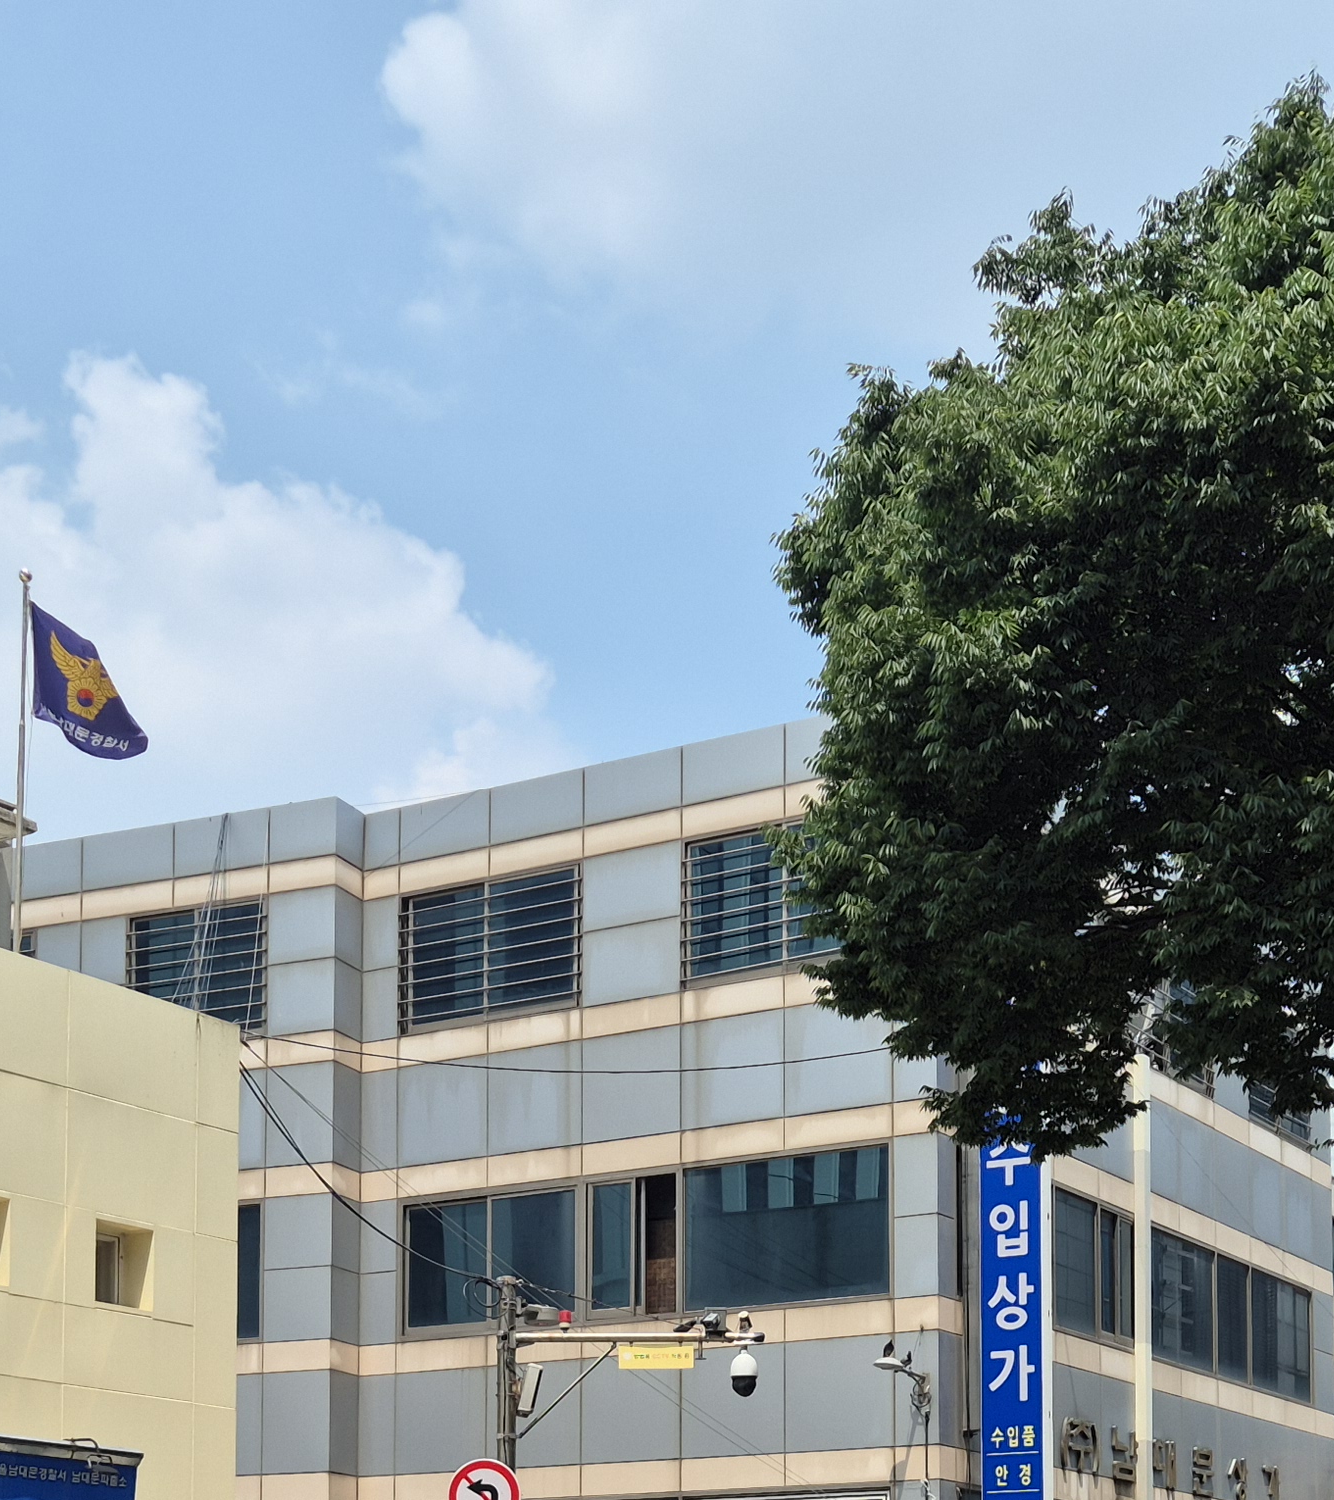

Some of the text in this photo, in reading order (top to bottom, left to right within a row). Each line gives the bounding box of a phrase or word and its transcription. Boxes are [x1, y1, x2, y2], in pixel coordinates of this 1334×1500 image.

[990, 1425, 1035, 1448] 수입품
[71, 1471, 128, 1488] 남대문파출소
[995, 1463, 1032, 1487] 안경
